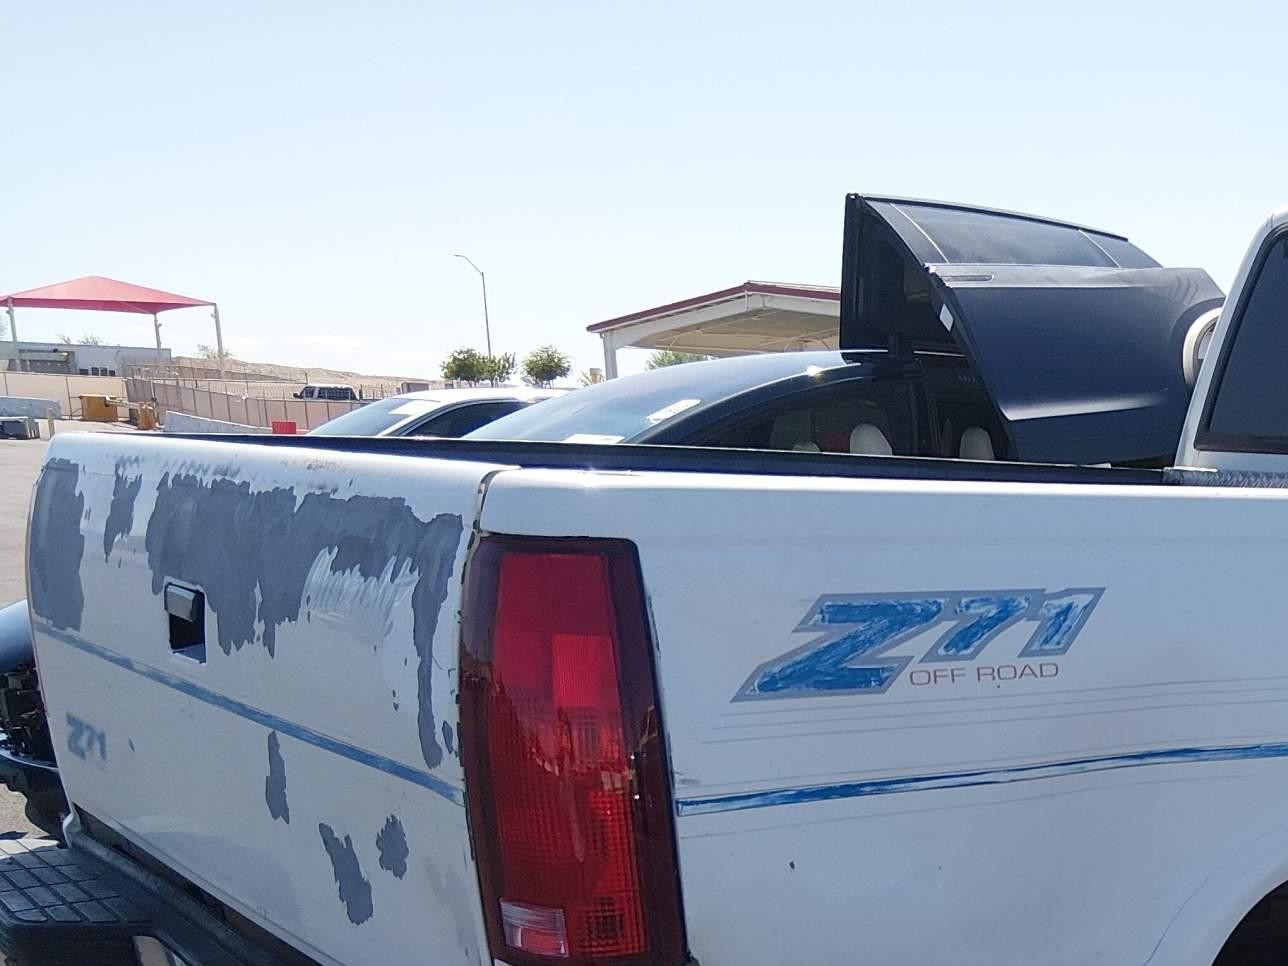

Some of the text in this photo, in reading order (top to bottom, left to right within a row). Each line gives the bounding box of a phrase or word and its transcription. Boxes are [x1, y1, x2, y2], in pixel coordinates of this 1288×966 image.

[730, 587, 1107, 703] Z71
[909, 662, 1060, 687] OFF ROAD
[66, 712, 107, 761] Z71
